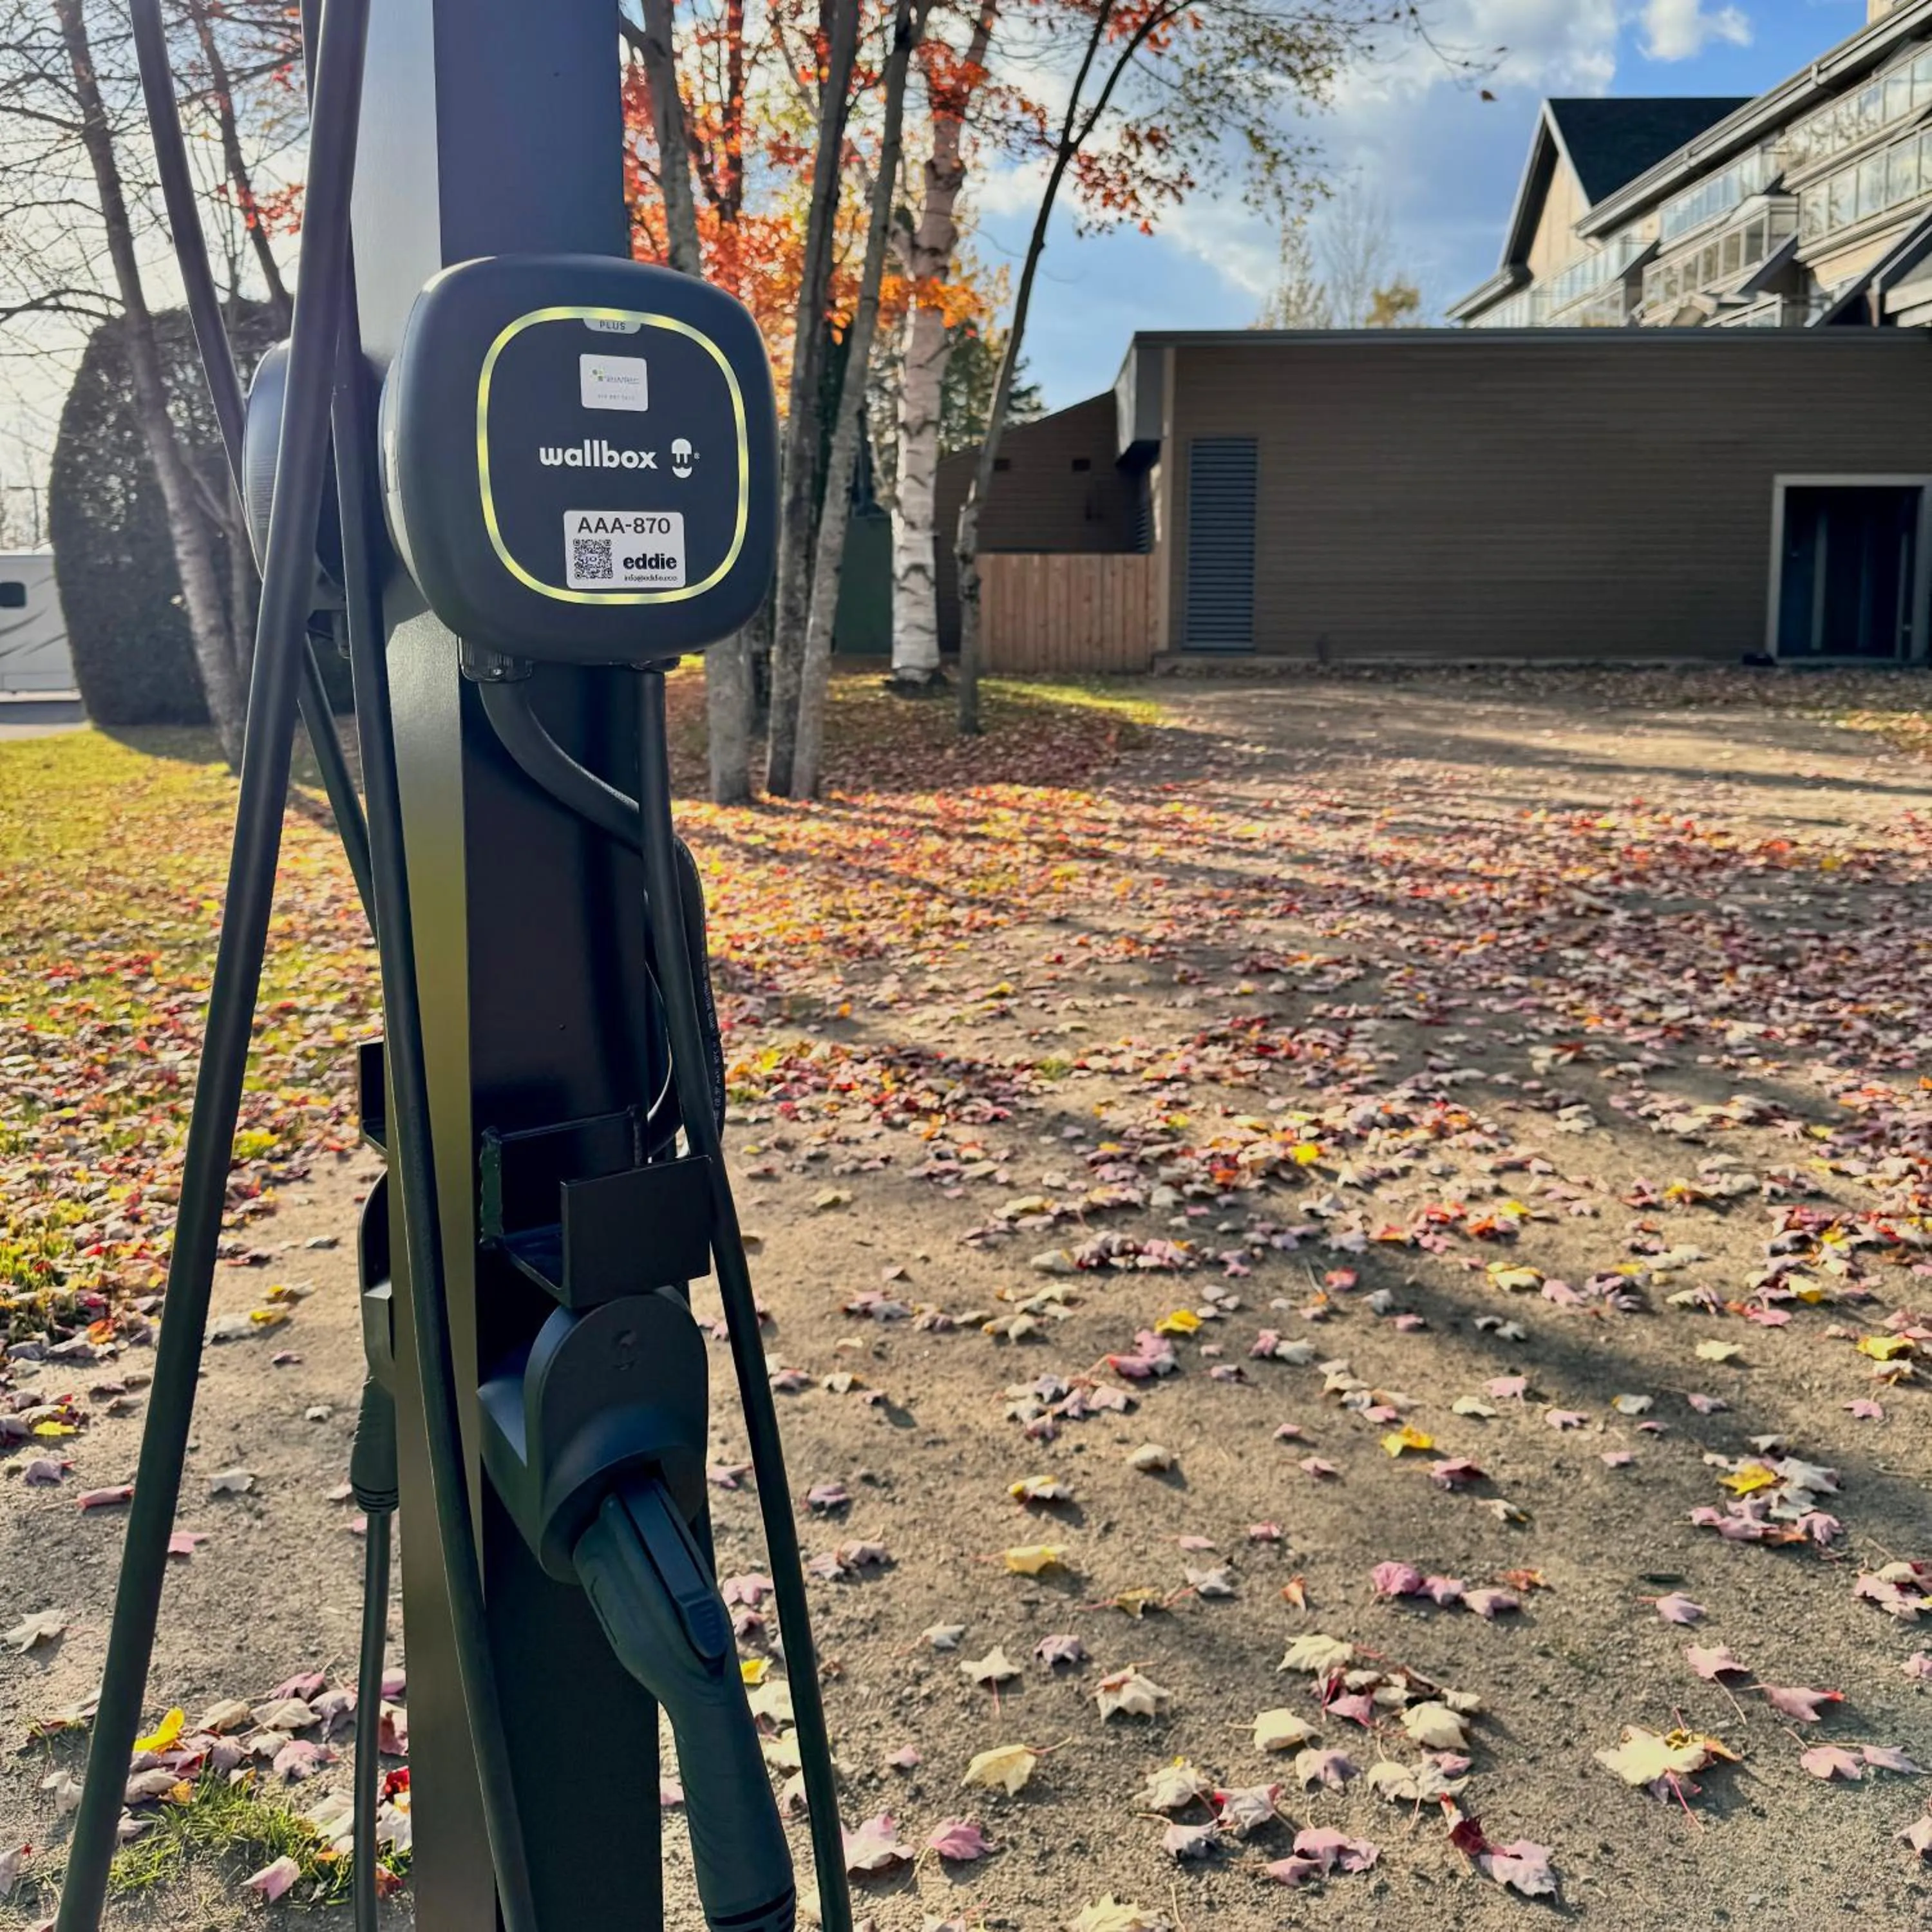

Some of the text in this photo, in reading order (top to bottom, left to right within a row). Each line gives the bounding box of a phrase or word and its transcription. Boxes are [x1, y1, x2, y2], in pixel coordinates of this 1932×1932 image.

[600, 319, 626, 330] PLUS
[539, 439, 658, 469] wallbox
[578, 517, 670, 534] AAA-870
[623, 553, 677, 570] eddie
